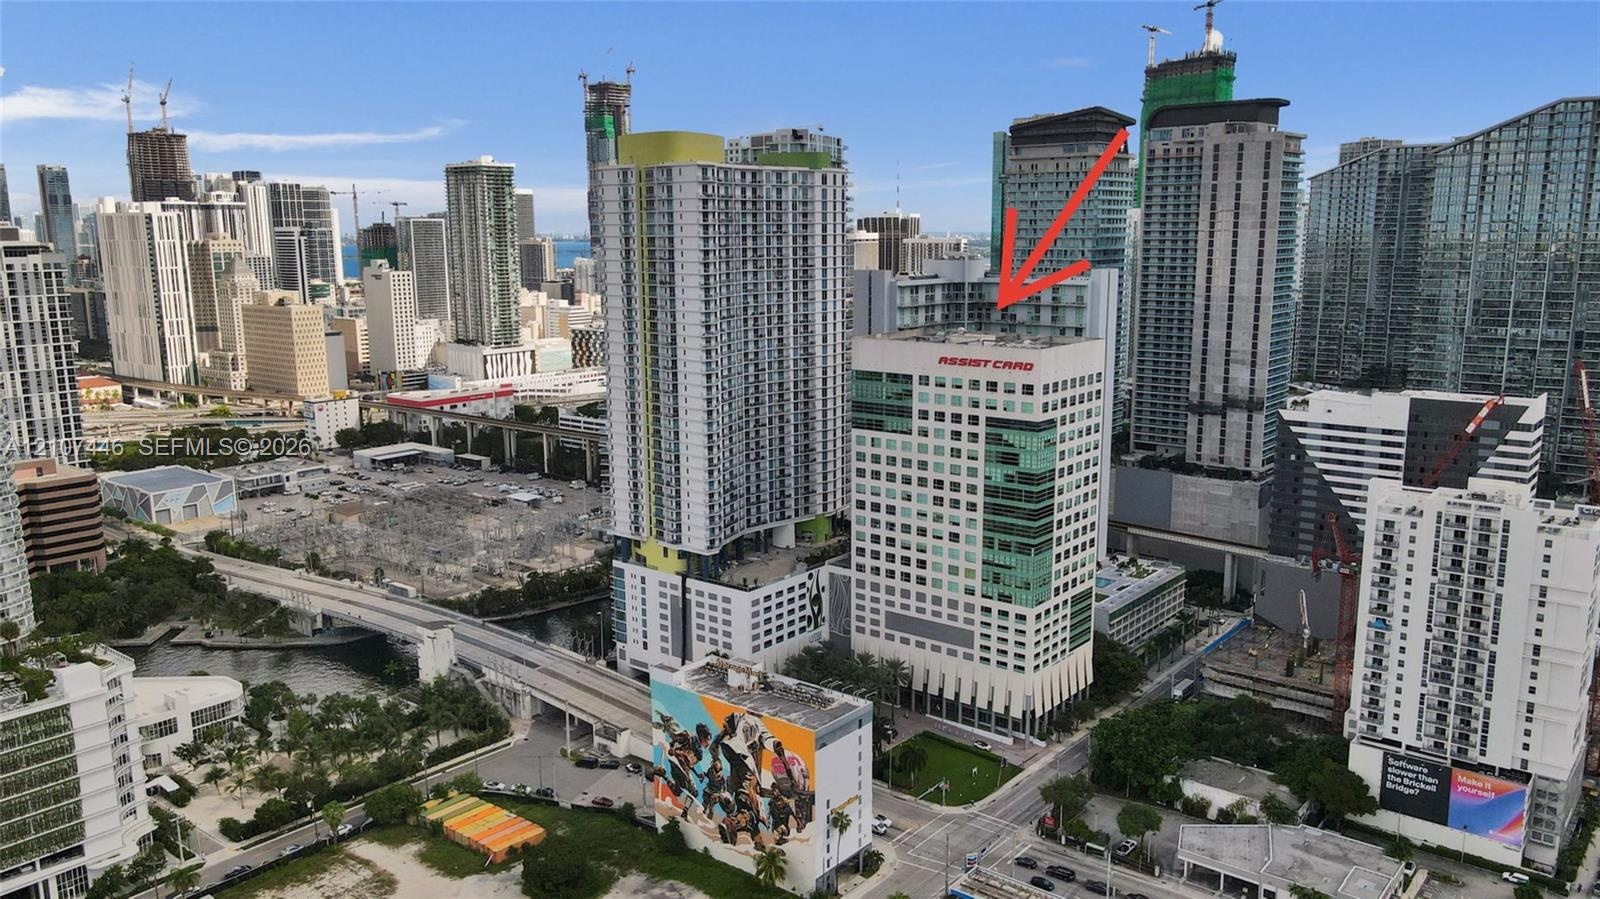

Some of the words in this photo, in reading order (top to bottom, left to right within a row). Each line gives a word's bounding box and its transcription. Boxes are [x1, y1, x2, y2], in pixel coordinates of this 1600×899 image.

[938, 356, 991, 368] ASSIST
[992, 360, 1034, 371] CARD
[1388, 757, 1429, 774] Software
[1387, 766, 1417, 779] slower
[1418, 773, 1439, 785] than
[1387, 773, 1402, 784] the
[1403, 777, 1437, 793] Brickell
[1457, 775, 1484, 788] Make
[1484, 782, 1492, 790] it
[1386, 780, 1420, 796] Bridge?
[1456, 784, 1496, 799] yourself
